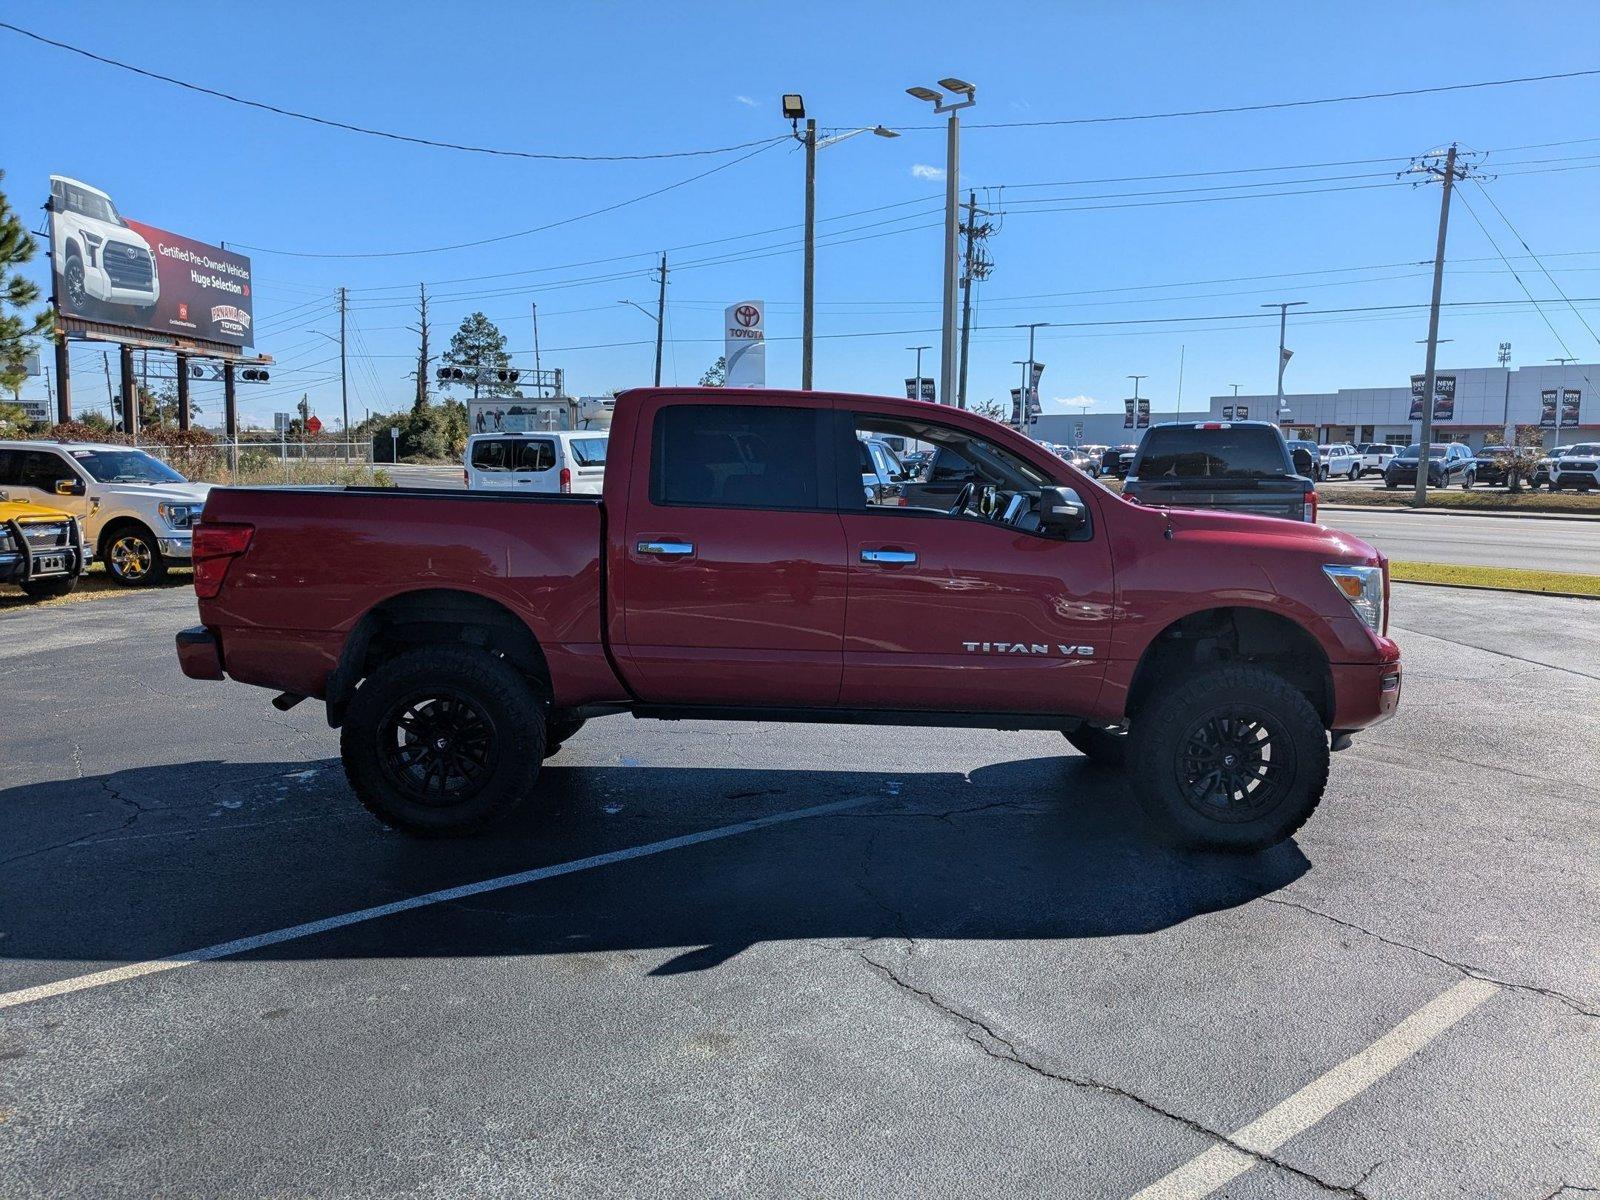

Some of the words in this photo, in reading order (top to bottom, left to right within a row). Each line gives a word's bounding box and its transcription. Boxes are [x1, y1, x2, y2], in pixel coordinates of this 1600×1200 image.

[159, 243, 189, 261] Certified
[190, 251, 225, 272] Pre-Owned
[226, 263, 249, 279] Vehicles
[191, 269, 211, 288] Huge
[211, 275, 242, 294] Selection
[221, 321, 244, 331] TOYOTA
[729, 328, 764, 339] TOYOTA
[962, 641, 1049, 654] TITAN
[1056, 643, 1094, 656] V8
